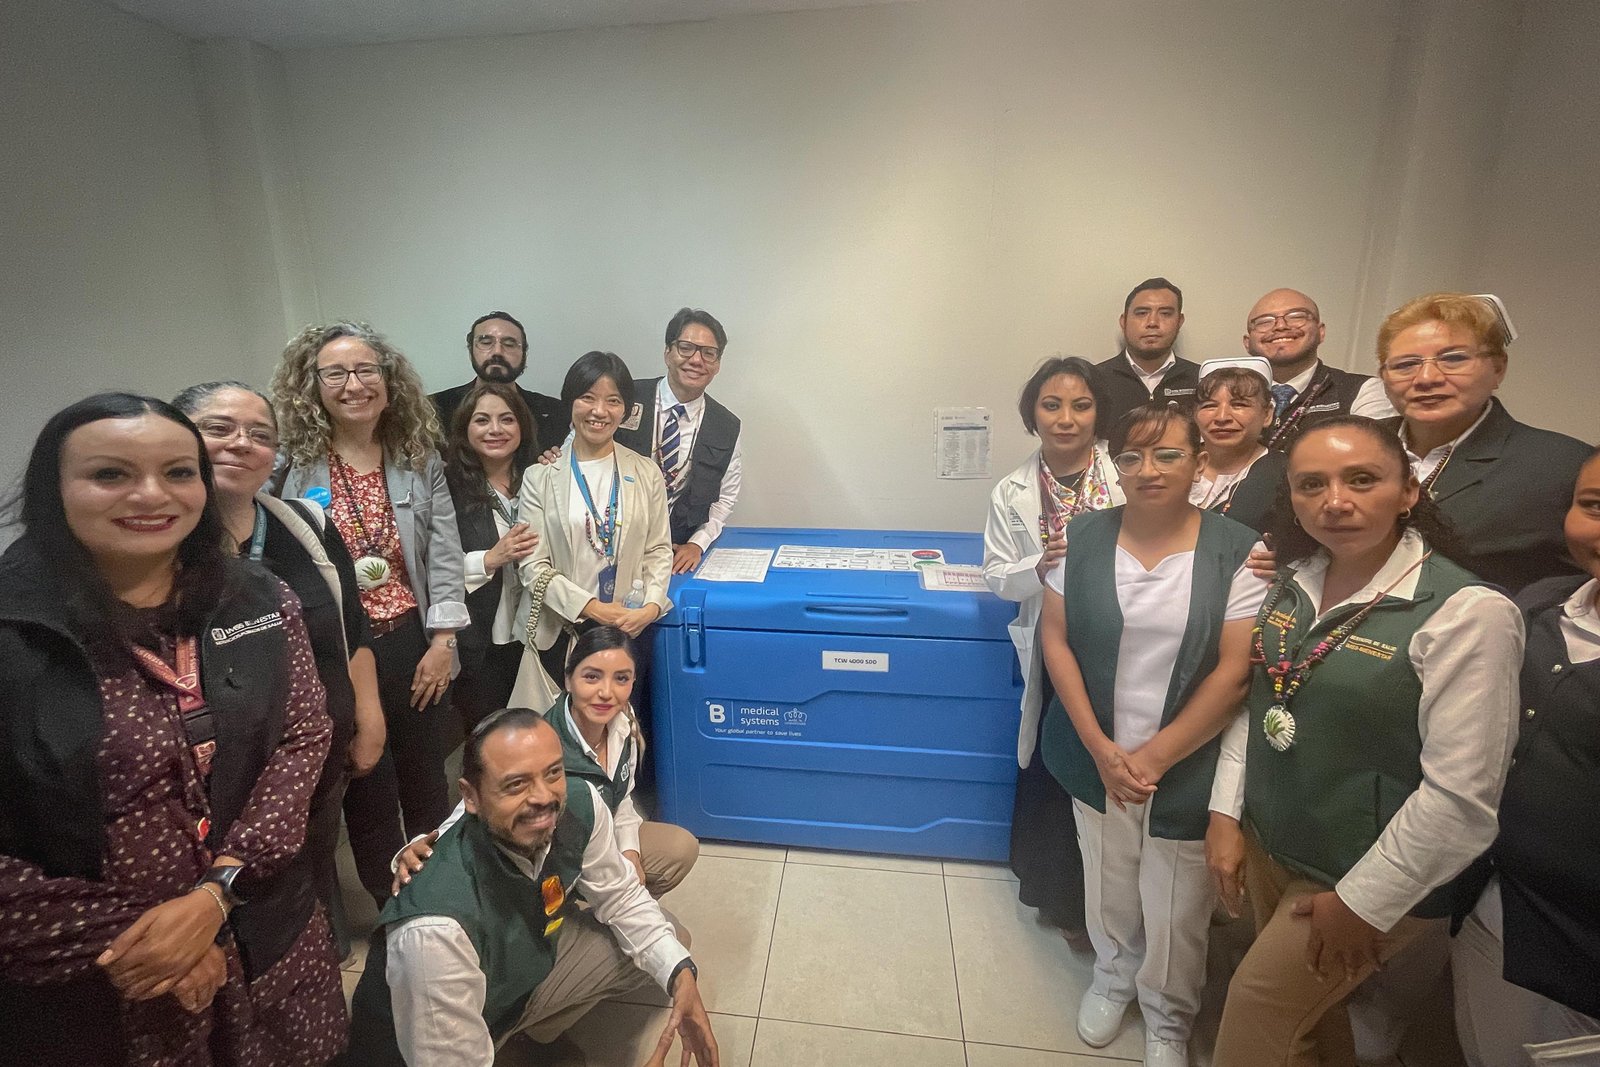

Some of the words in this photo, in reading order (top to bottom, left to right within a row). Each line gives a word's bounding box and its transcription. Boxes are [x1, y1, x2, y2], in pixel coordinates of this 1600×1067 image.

[709, 703, 726, 724] B
[740, 706, 780, 717] medical
[740, 716, 780, 727] systems
